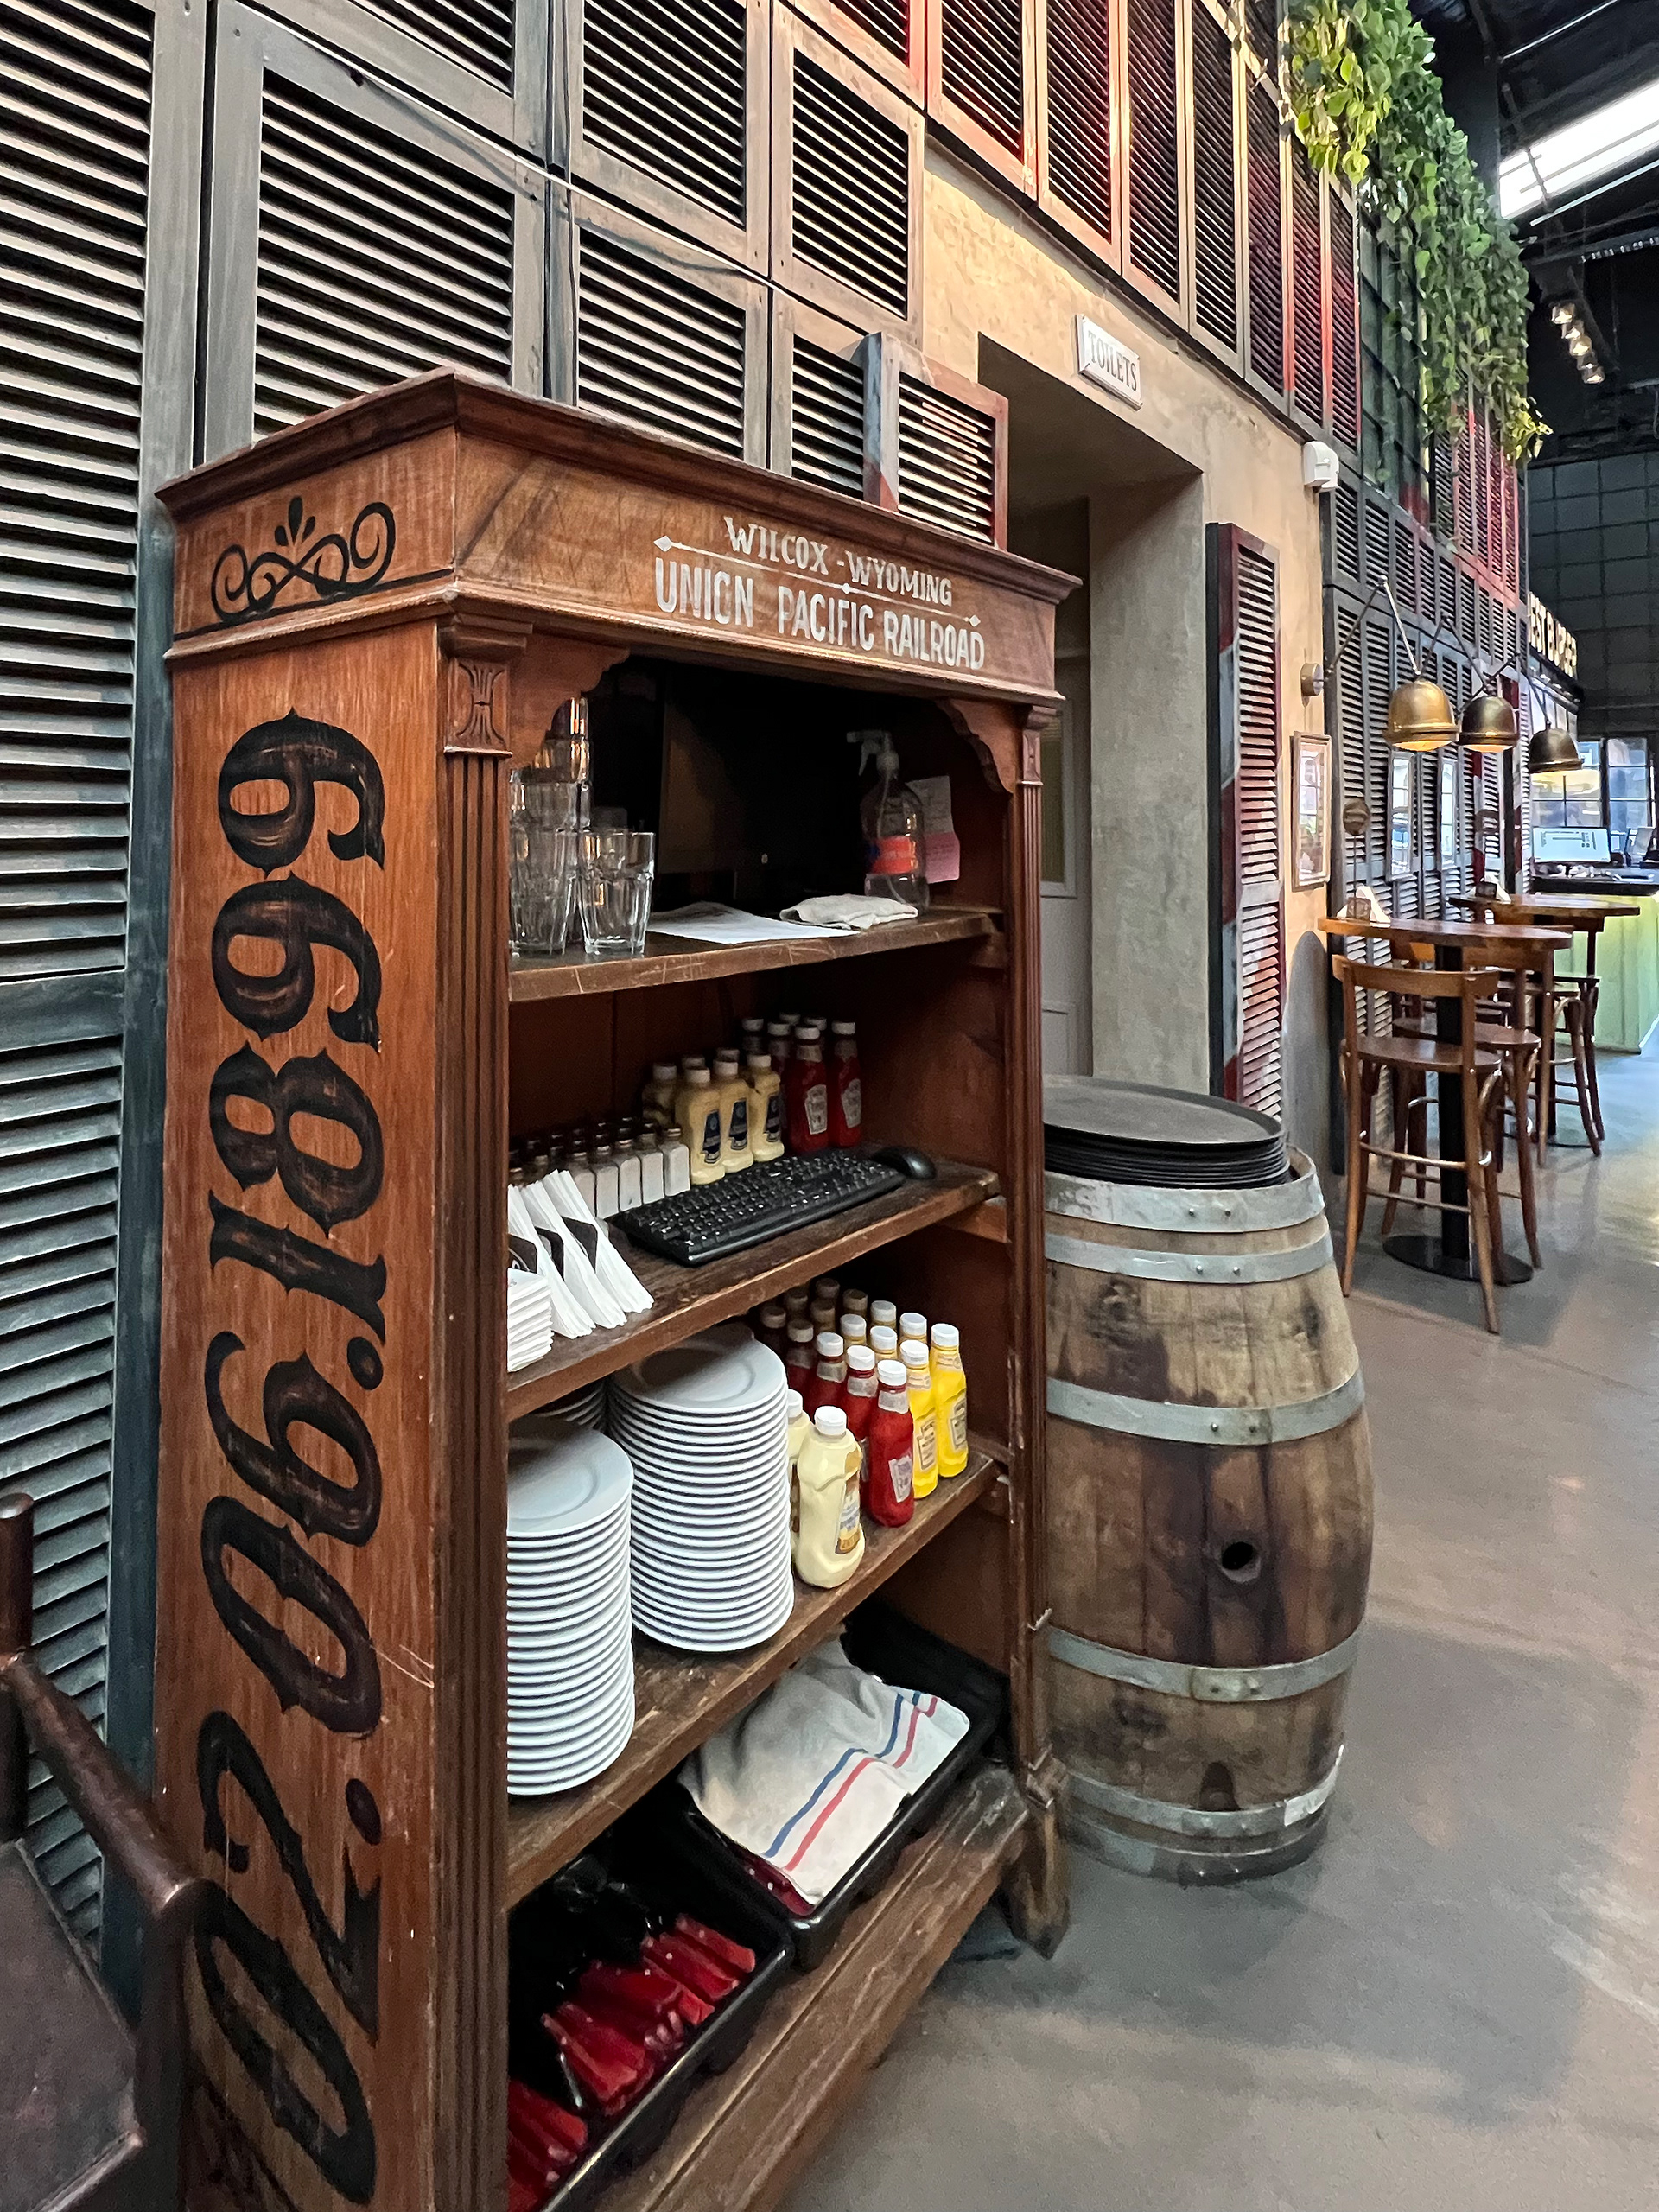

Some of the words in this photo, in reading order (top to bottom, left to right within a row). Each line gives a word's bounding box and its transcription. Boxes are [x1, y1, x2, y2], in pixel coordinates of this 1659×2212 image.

[1088, 330, 1137, 391] TOILETS
[723, 516, 829, 575] WILCOX
[655, 557, 753, 628] UNION
[778, 585, 874, 651] PACIFIC
[883, 610, 985, 671] RAILROAD
[193, 707, 386, 2205] 02.06.1899
